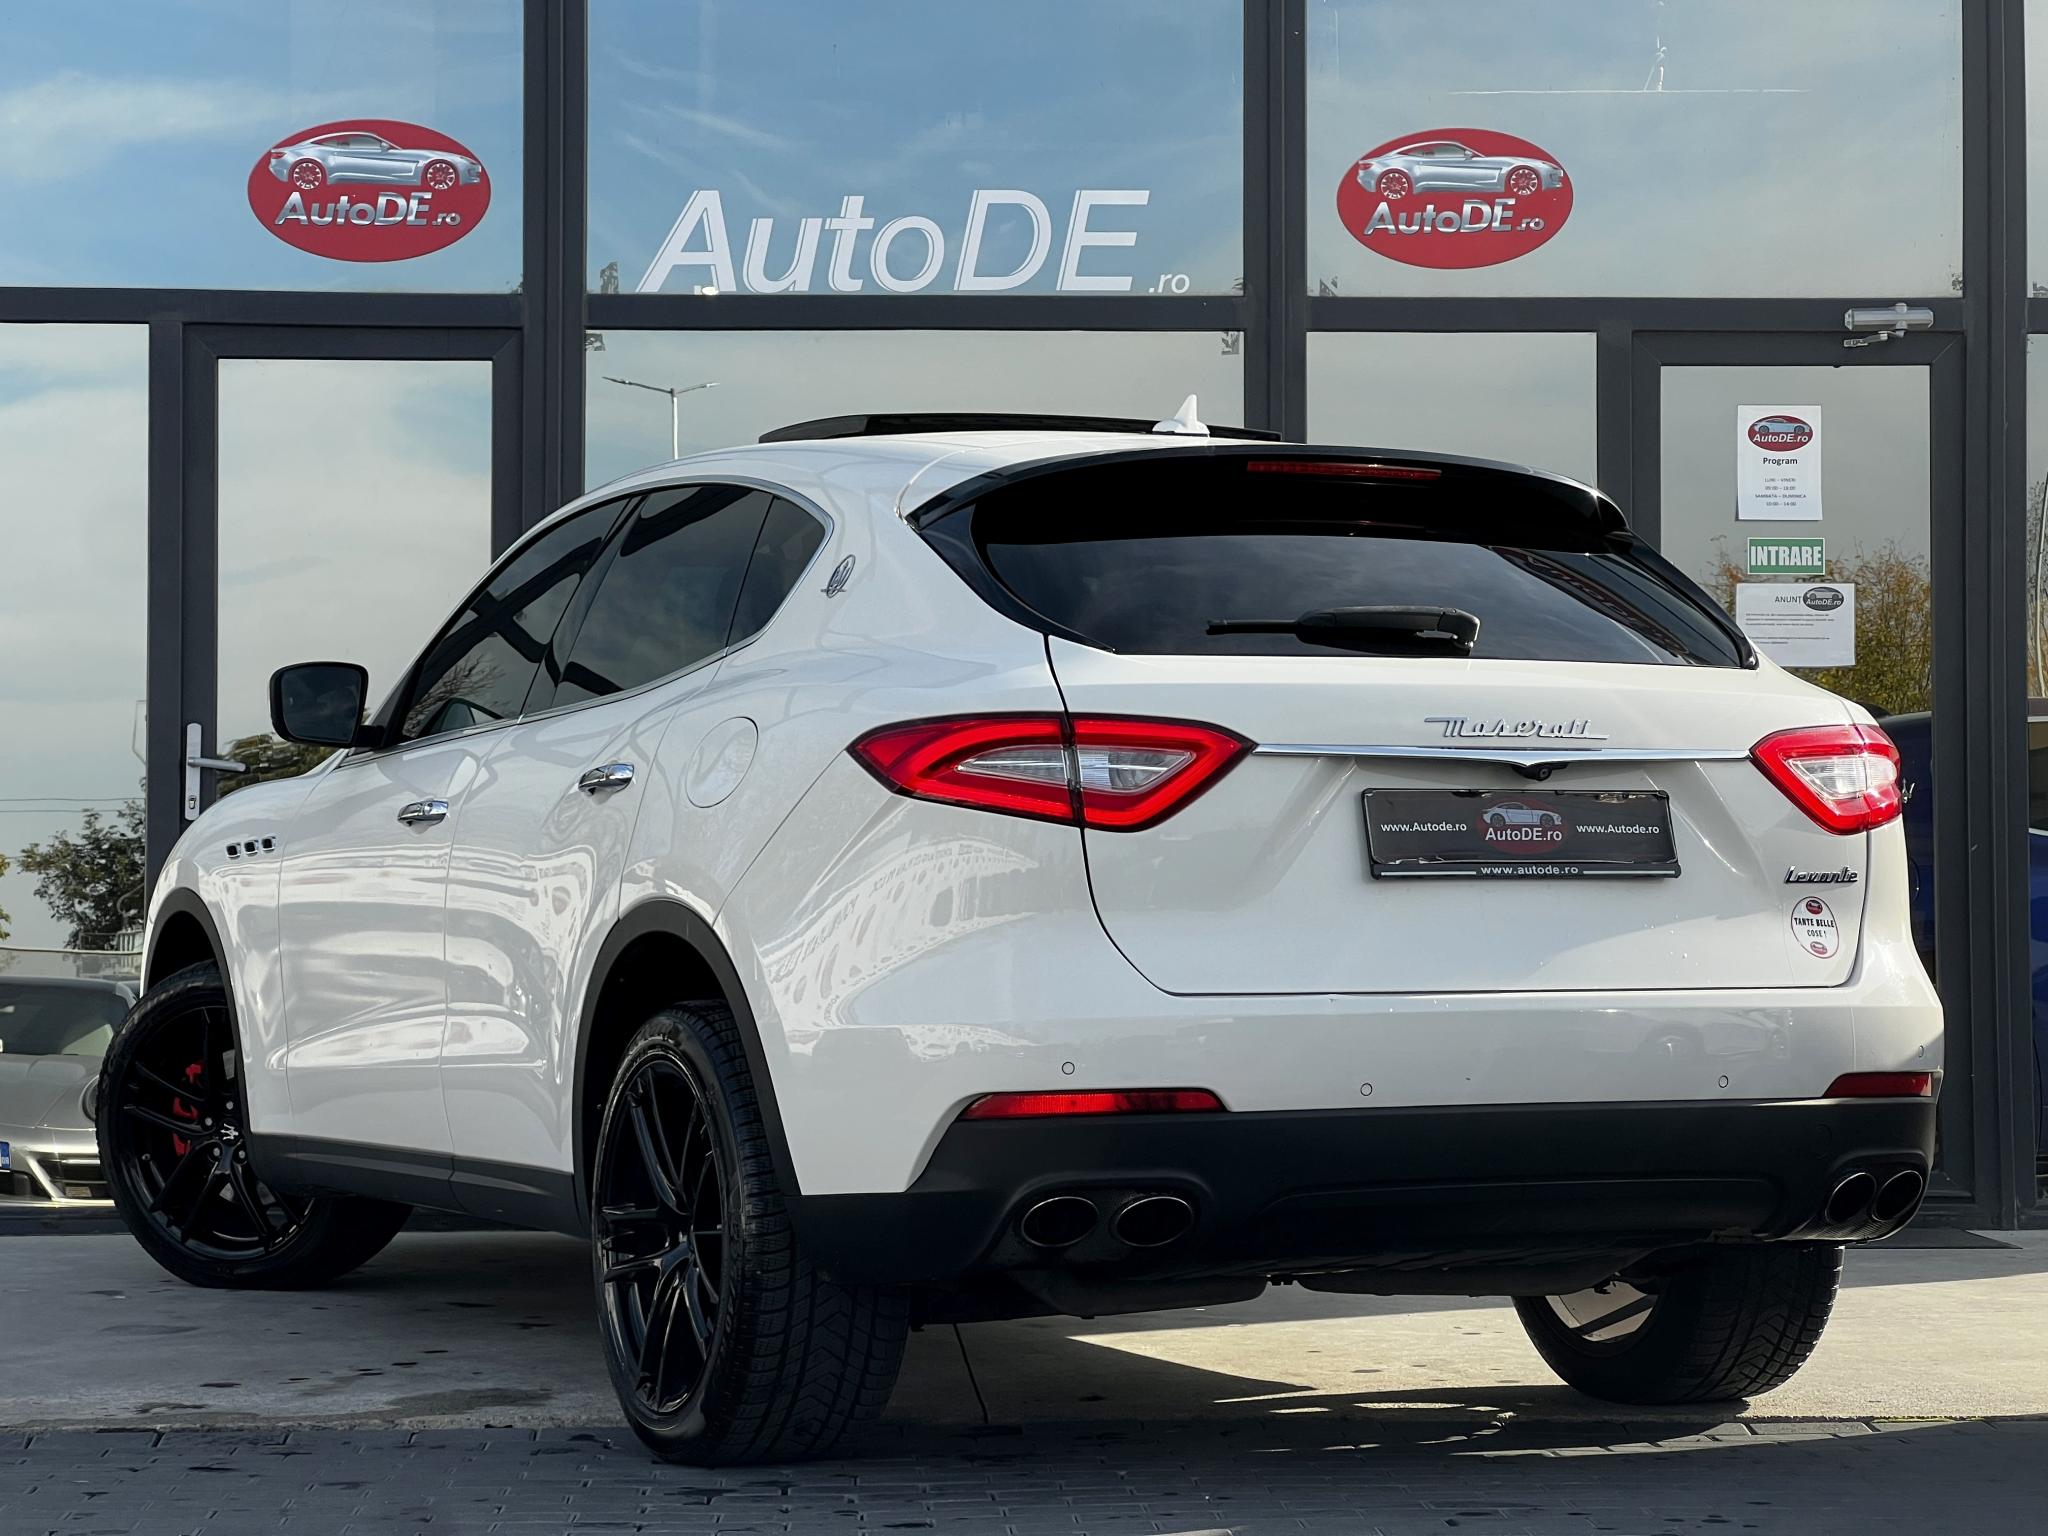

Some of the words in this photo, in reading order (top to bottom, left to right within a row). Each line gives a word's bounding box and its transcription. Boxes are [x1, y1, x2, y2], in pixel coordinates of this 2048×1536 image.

[274, 191, 461, 226] AutoDE.ro
[1363, 198, 1545, 235] AutoDE.ro
[635, 189, 1190, 294] AutoDE.ro
[1753, 433, 1809, 443] AutoDE.ro
[1763, 457, 1798, 466] Program
[1750, 546, 1822, 566] INTRARE
[1424, 716, 1610, 741] Maserati
[1380, 821, 1468, 833] www.Autode.ro
[1485, 827, 1563, 842] AutoDE.ro
[1576, 823, 1660, 835] www.Autode.ro
[1480, 865, 1579, 876] www.autode.ro
[1784, 865, 1858, 884] Levante
[1793, 917, 1815, 927] TANTE
[1816, 919, 1835, 928] BELLE
